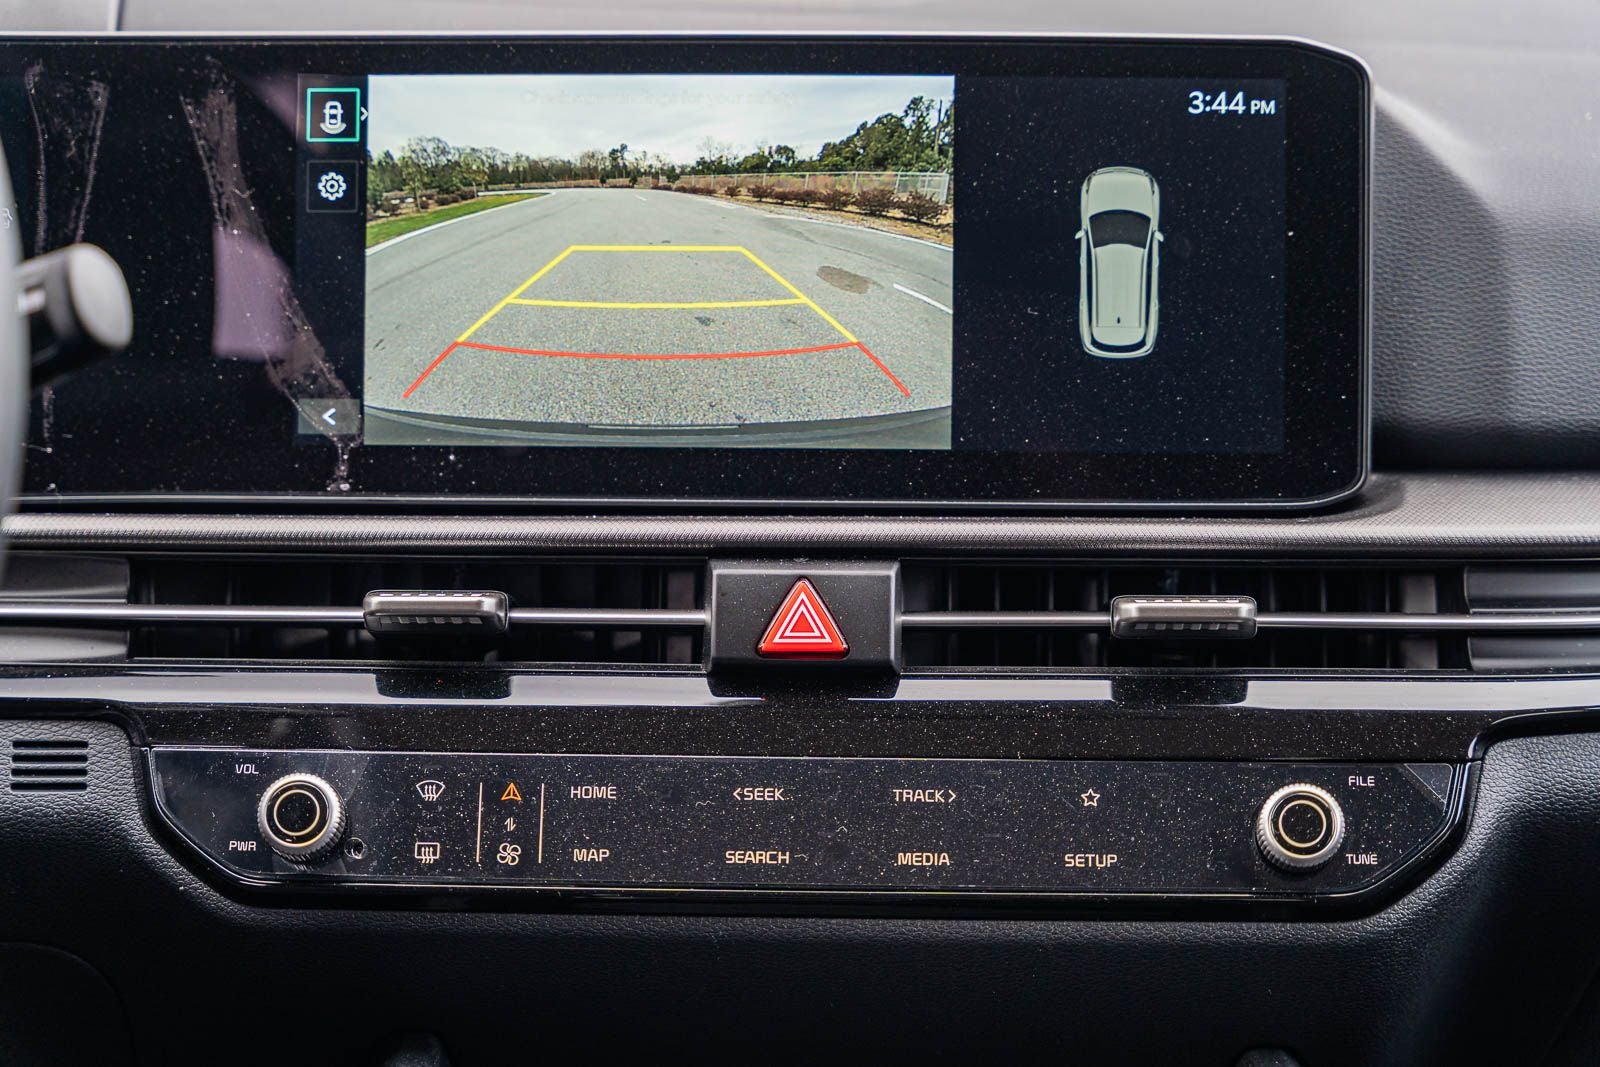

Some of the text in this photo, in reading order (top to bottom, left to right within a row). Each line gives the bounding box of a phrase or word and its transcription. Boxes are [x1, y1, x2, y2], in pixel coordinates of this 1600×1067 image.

[1187, 90, 1277, 115] 3:44 PM
[234, 763, 260, 775] VOL
[1348, 775, 1376, 787] FILE
[570, 785, 617, 801] HOME
[228, 840, 257, 852] PWR
[573, 848, 611, 863] MAP
[725, 850, 791, 866] SEARCH
[897, 852, 951, 866] MEDIA
[1064, 853, 1118, 869] SETUP
[1345, 853, 1378, 865] TUNE
